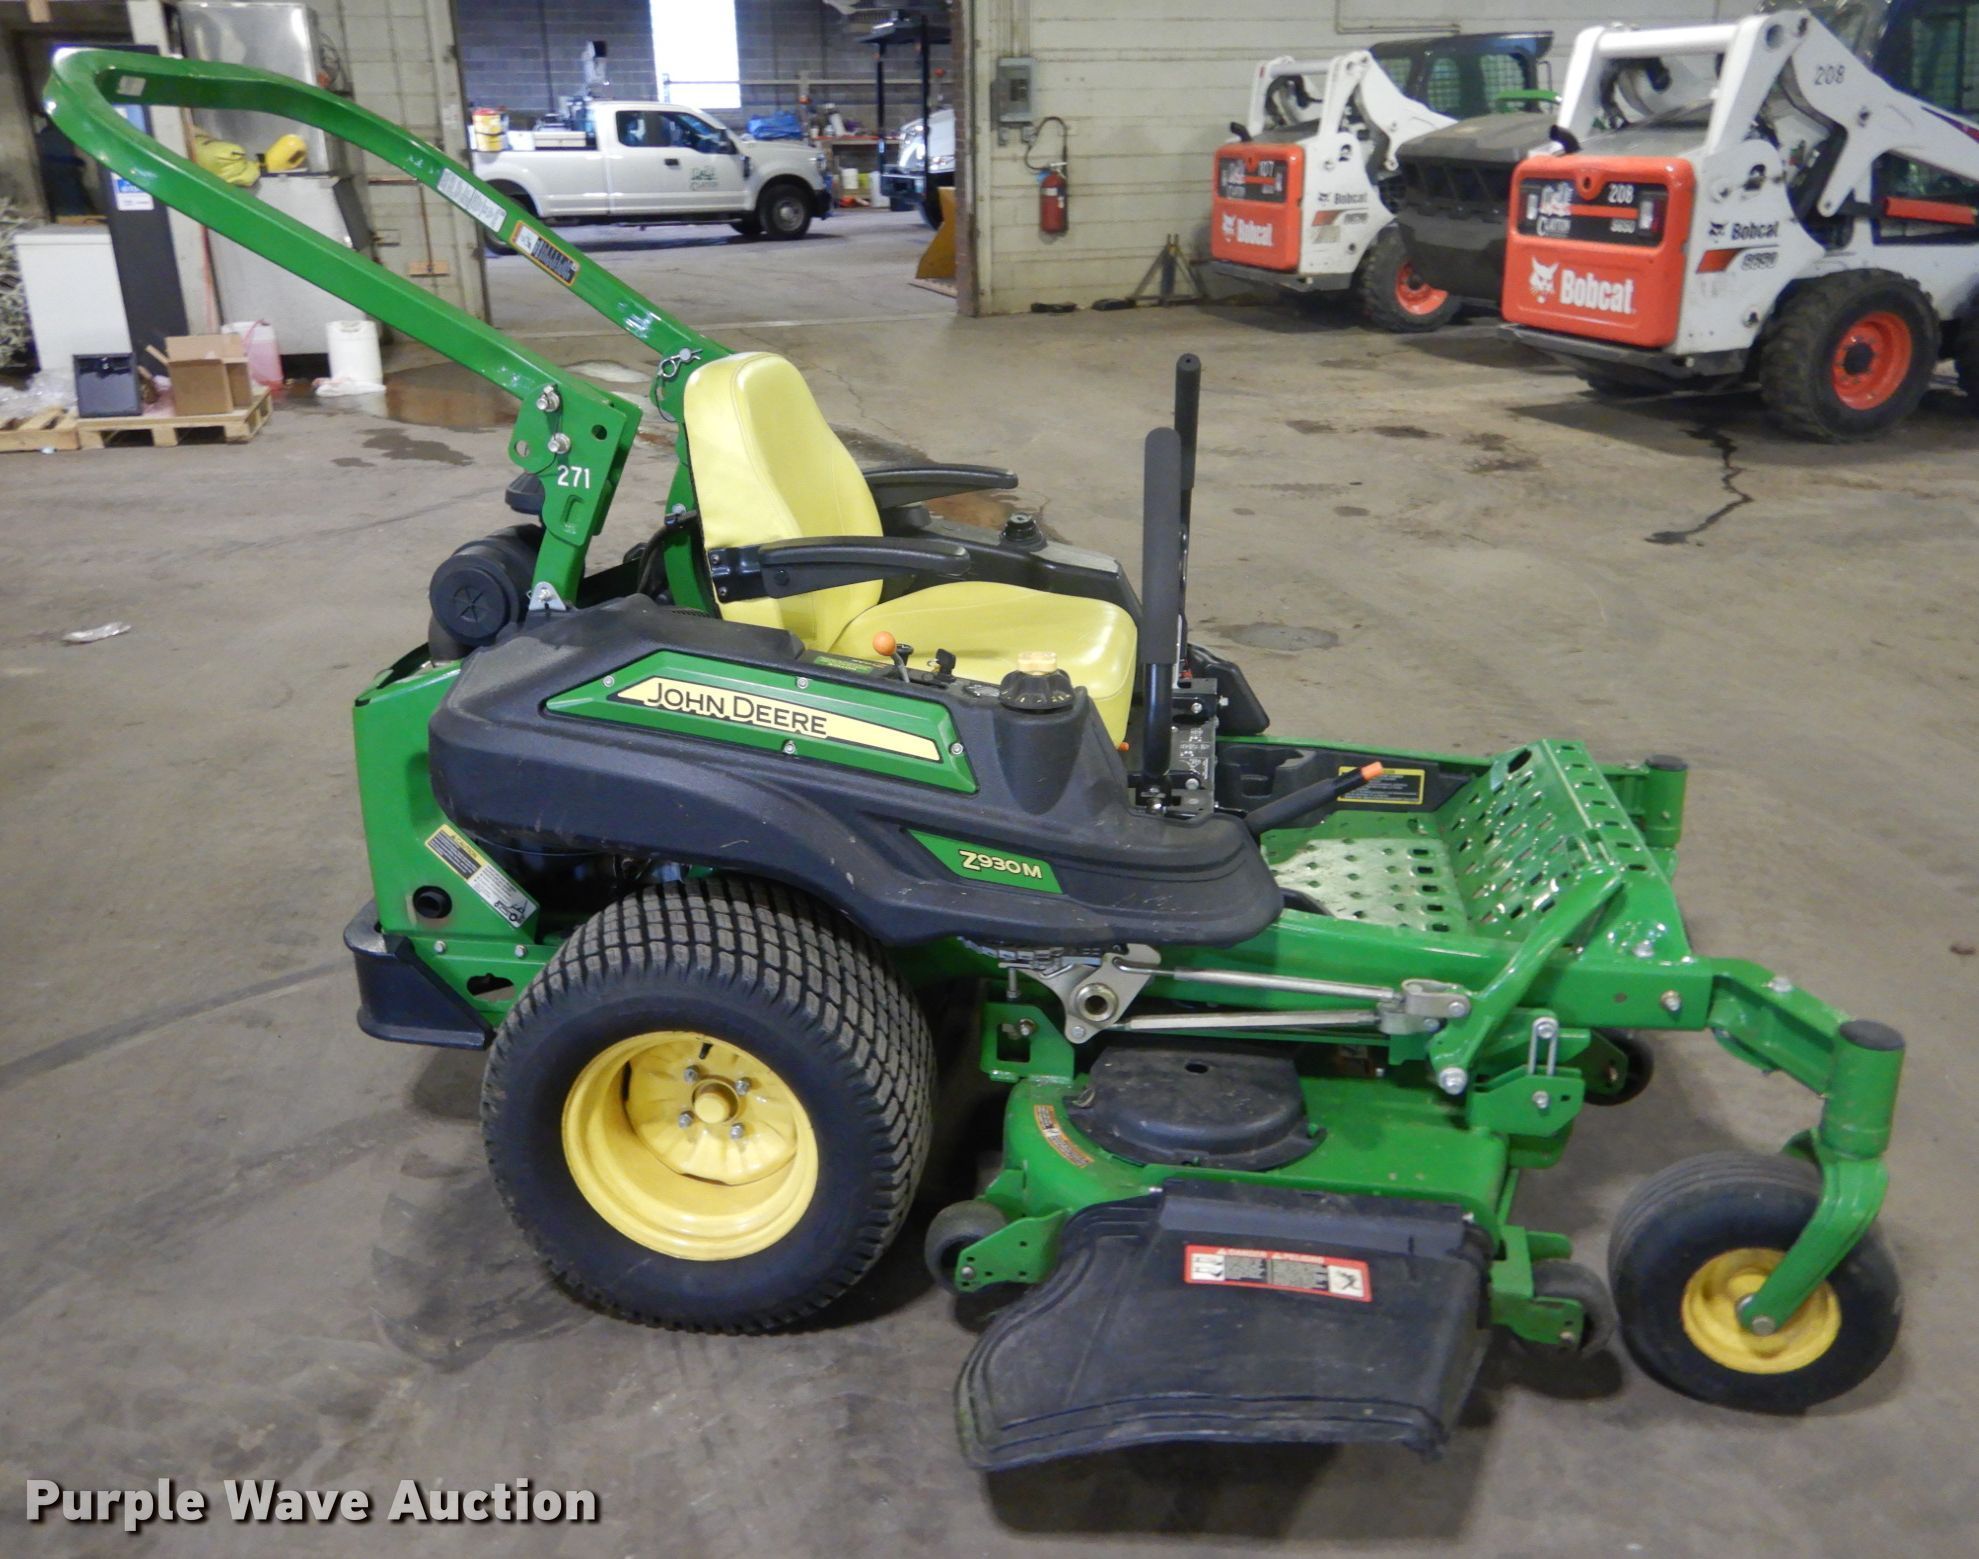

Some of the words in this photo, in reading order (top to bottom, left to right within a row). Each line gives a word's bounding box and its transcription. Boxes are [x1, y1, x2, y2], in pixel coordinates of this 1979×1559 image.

[1814, 64, 1846, 86] 208
[1334, 192, 1369, 205] Bobcat
[1608, 183, 1634, 204] 208
[1237, 218, 1274, 247] Bobcat
[1731, 220, 1779, 241] Bobcat
[1559, 268, 1635, 315] Bobcat
[557, 464, 590, 489] 271
[647, 682, 725, 715] JOHN
[733, 695, 827, 736] DEERE
[959, 849, 1043, 879] Z930M
